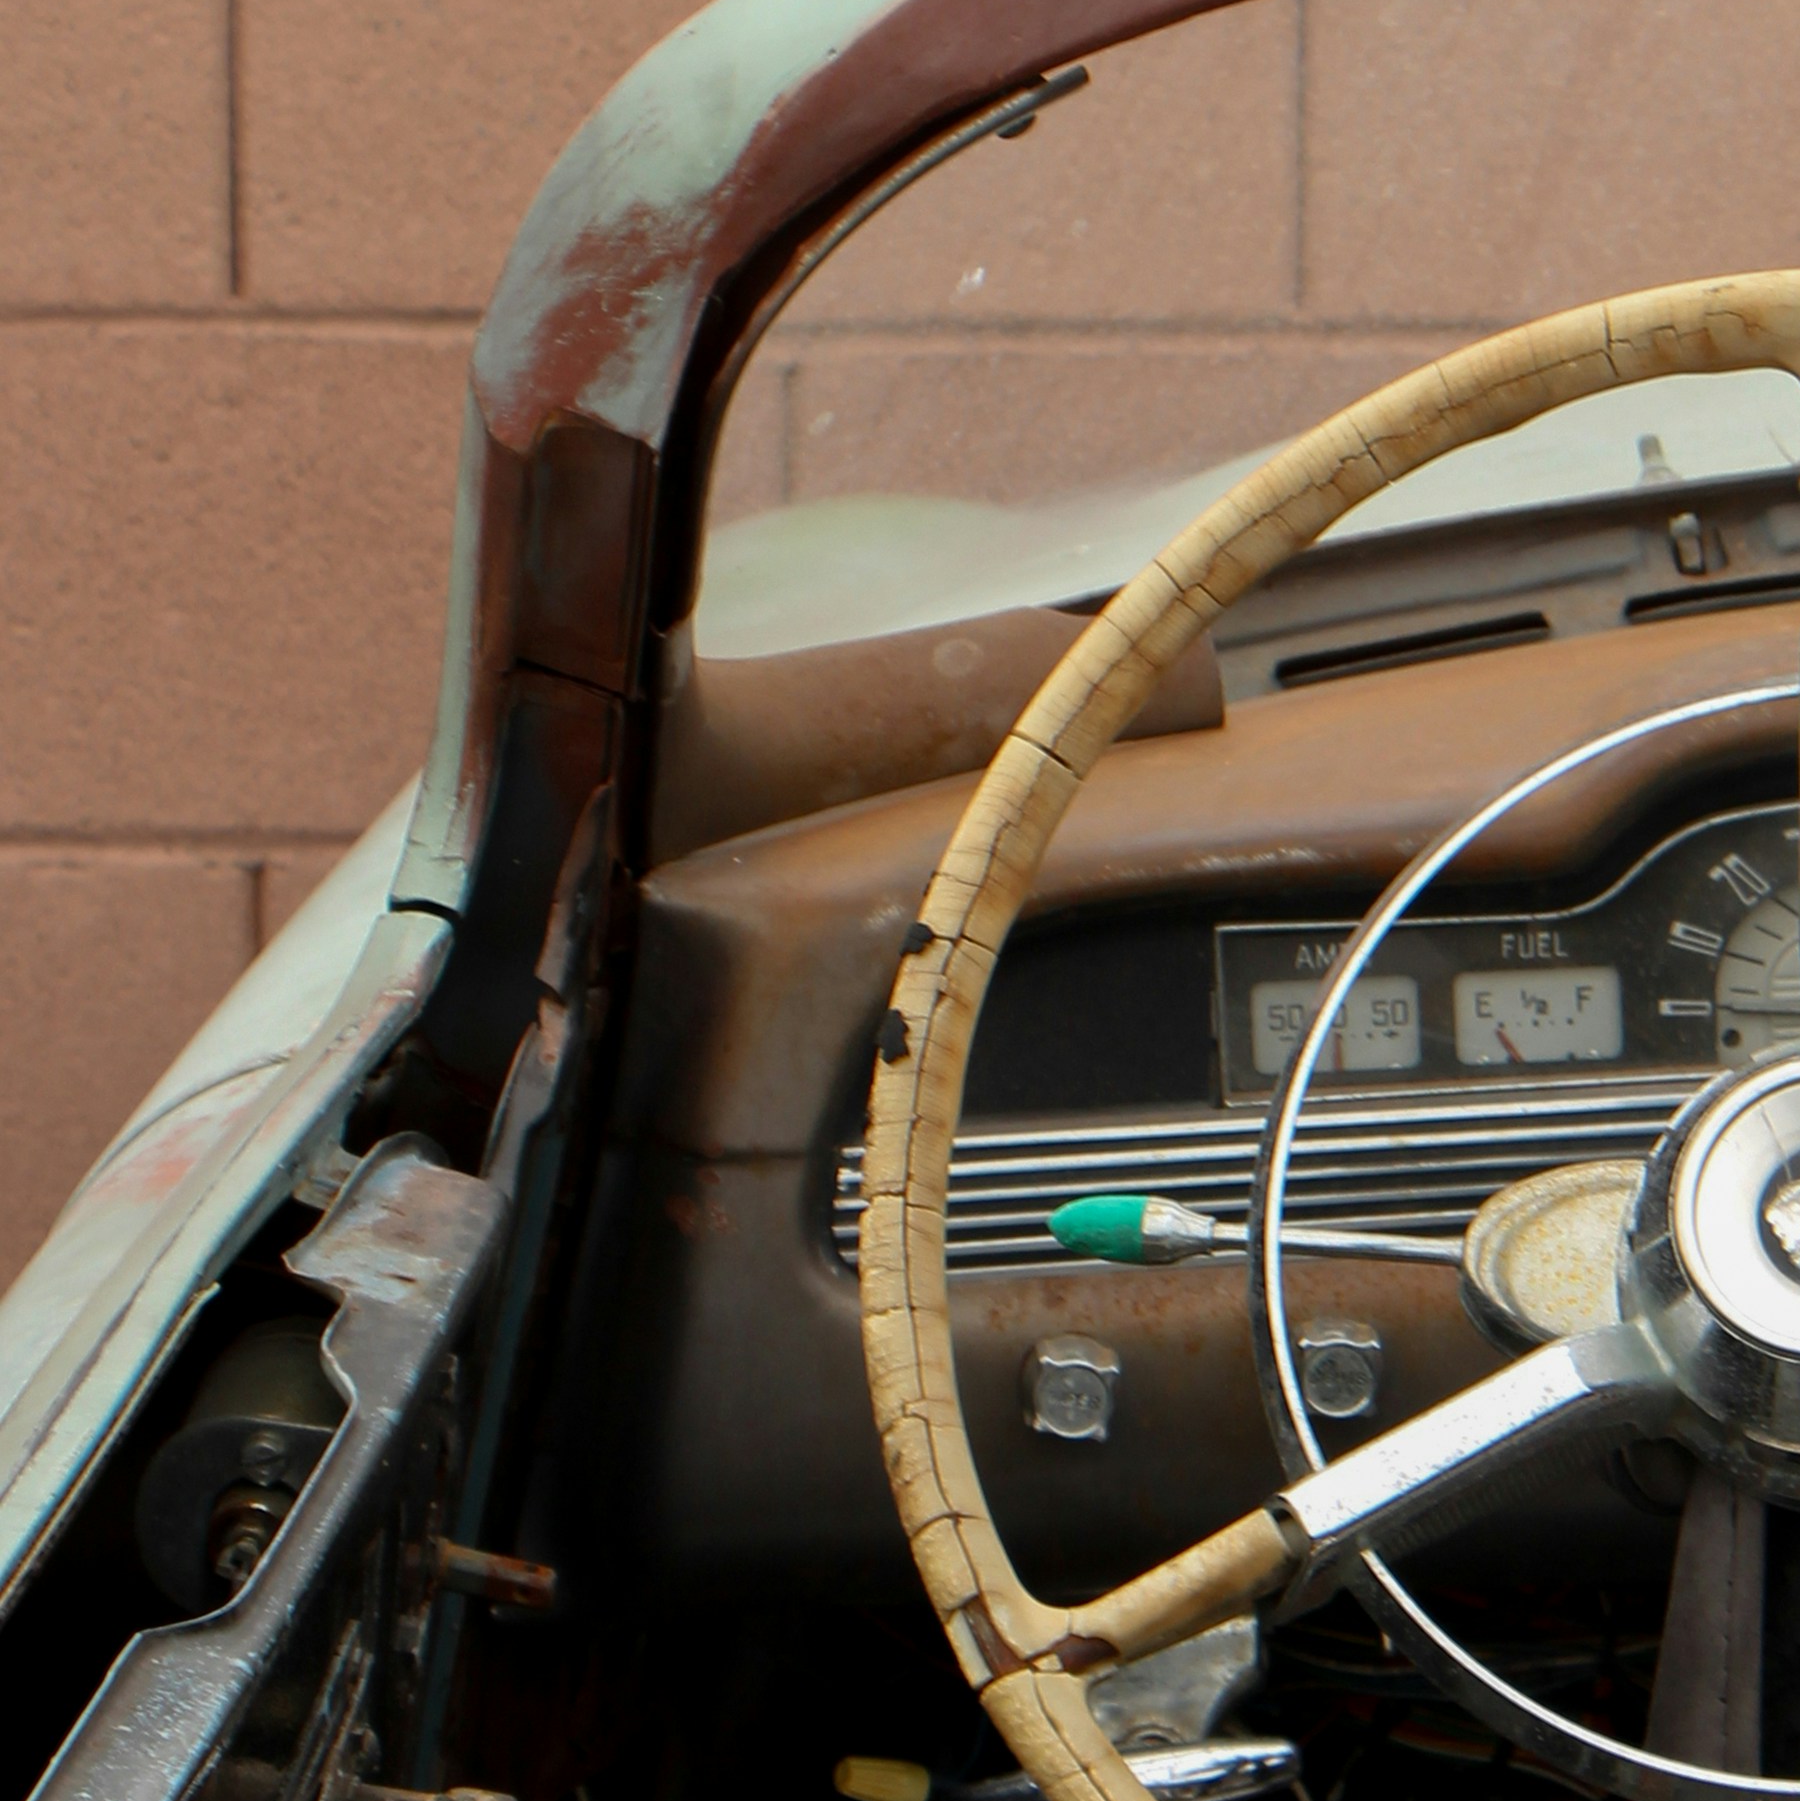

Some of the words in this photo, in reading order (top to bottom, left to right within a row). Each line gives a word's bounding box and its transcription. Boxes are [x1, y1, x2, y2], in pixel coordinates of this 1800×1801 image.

[1707, 852, 1771, 906] 20
[1501, 931, 1569, 960] FUEL
[1667, 920, 1724, 958] 10
[1268, 1003, 1304, 1031] 50
[1371, 999, 1409, 1027] 50
[1474, 990, 1493, 1018] E
[1575, 984, 1594, 1013] F
